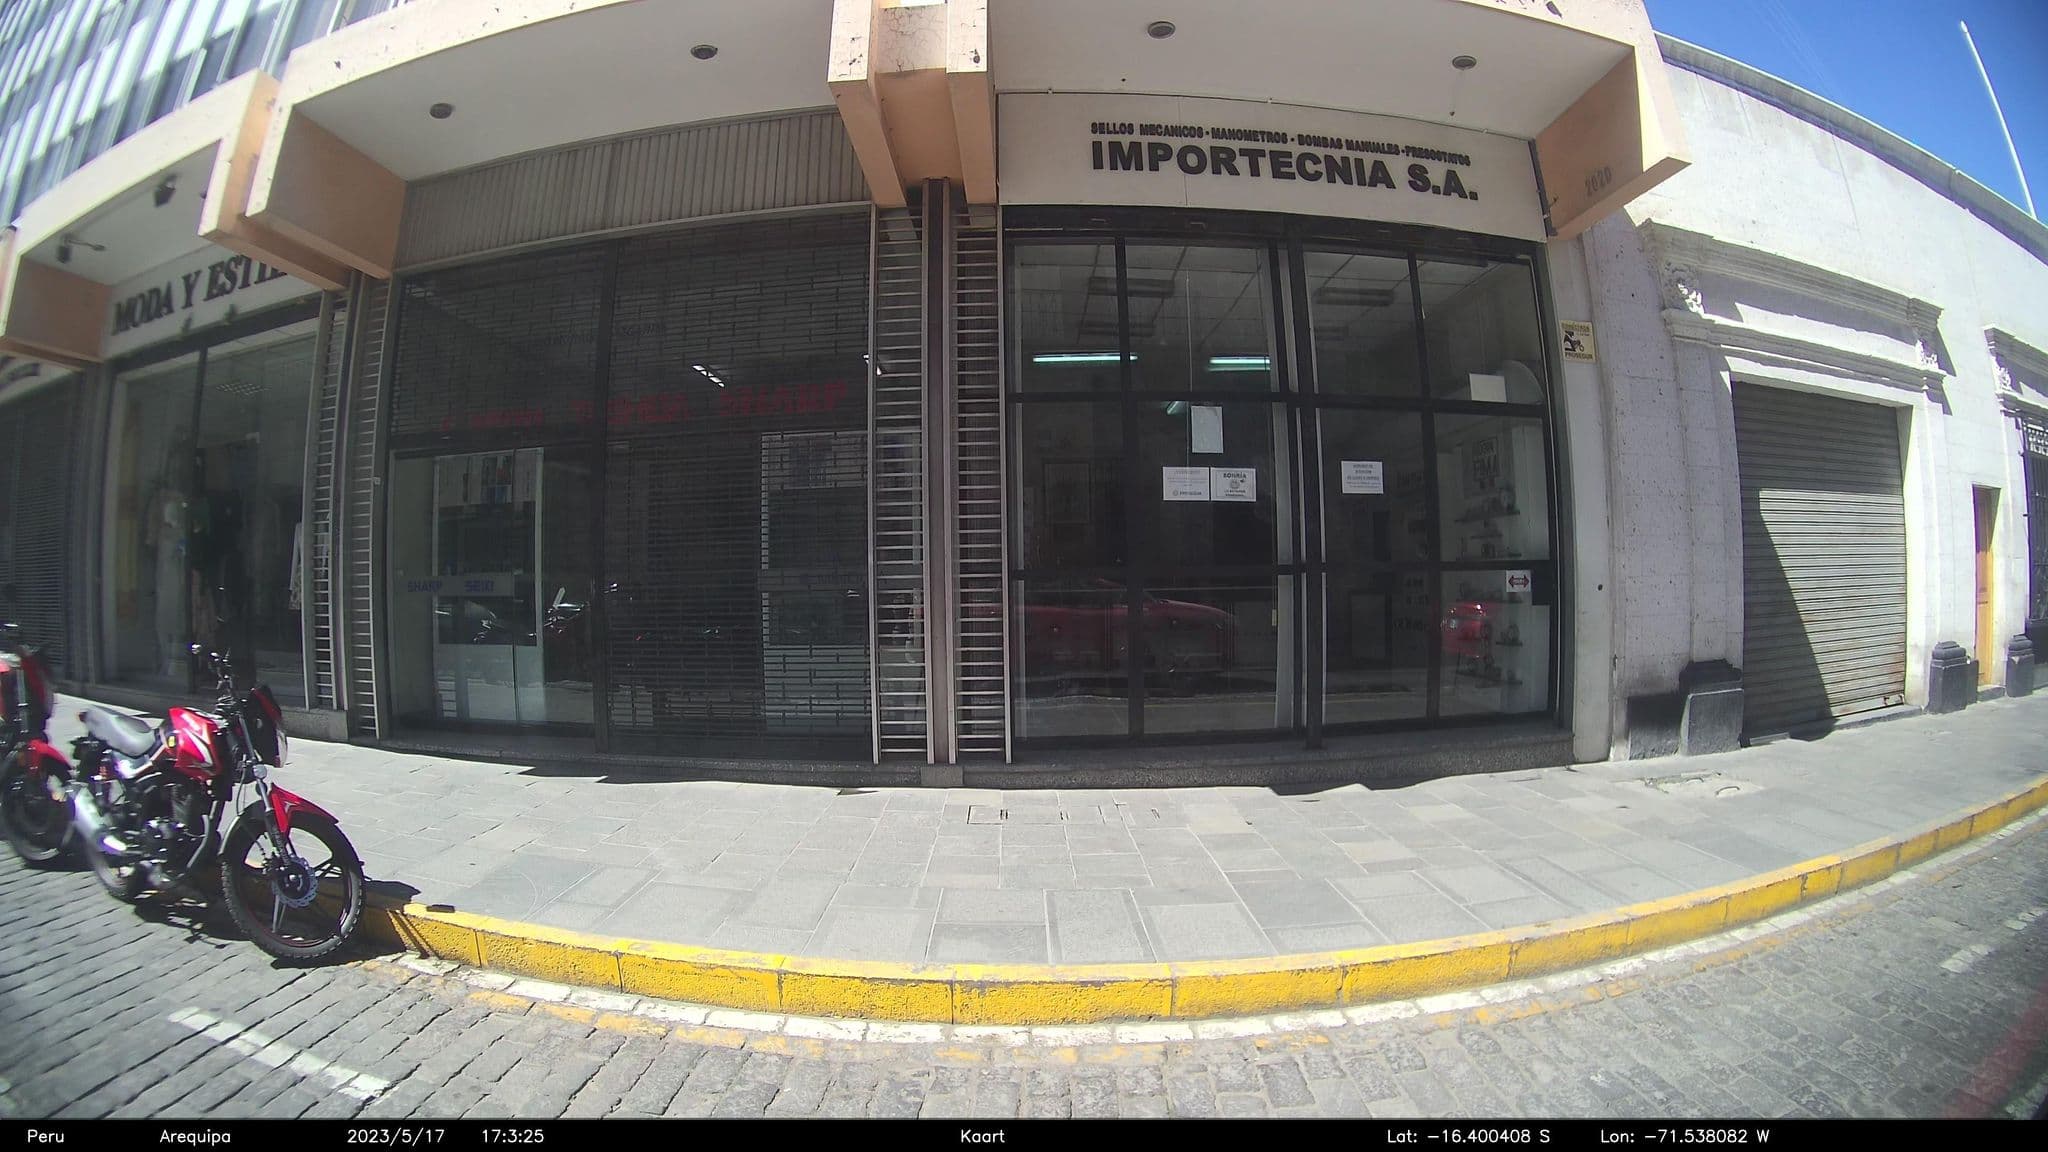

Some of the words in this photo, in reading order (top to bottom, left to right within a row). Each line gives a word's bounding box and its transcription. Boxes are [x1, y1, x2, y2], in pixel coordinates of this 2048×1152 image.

[1091, 122, 1134, 135] SELLOS
[1139, 123, 1203, 140] MECANICOS
[1211, 127, 1289, 146] MANOMETROS
[1297, 134, 1344, 150] BOMBAS
[1345, 139, 1400, 156] MANUALES
[1091, 141, 1397, 190] IMPORTECNIA
[1407, 163, 1479, 201] S.A.
[111, 280, 174, 336] MODA
[181, 269, 203, 309] Y
